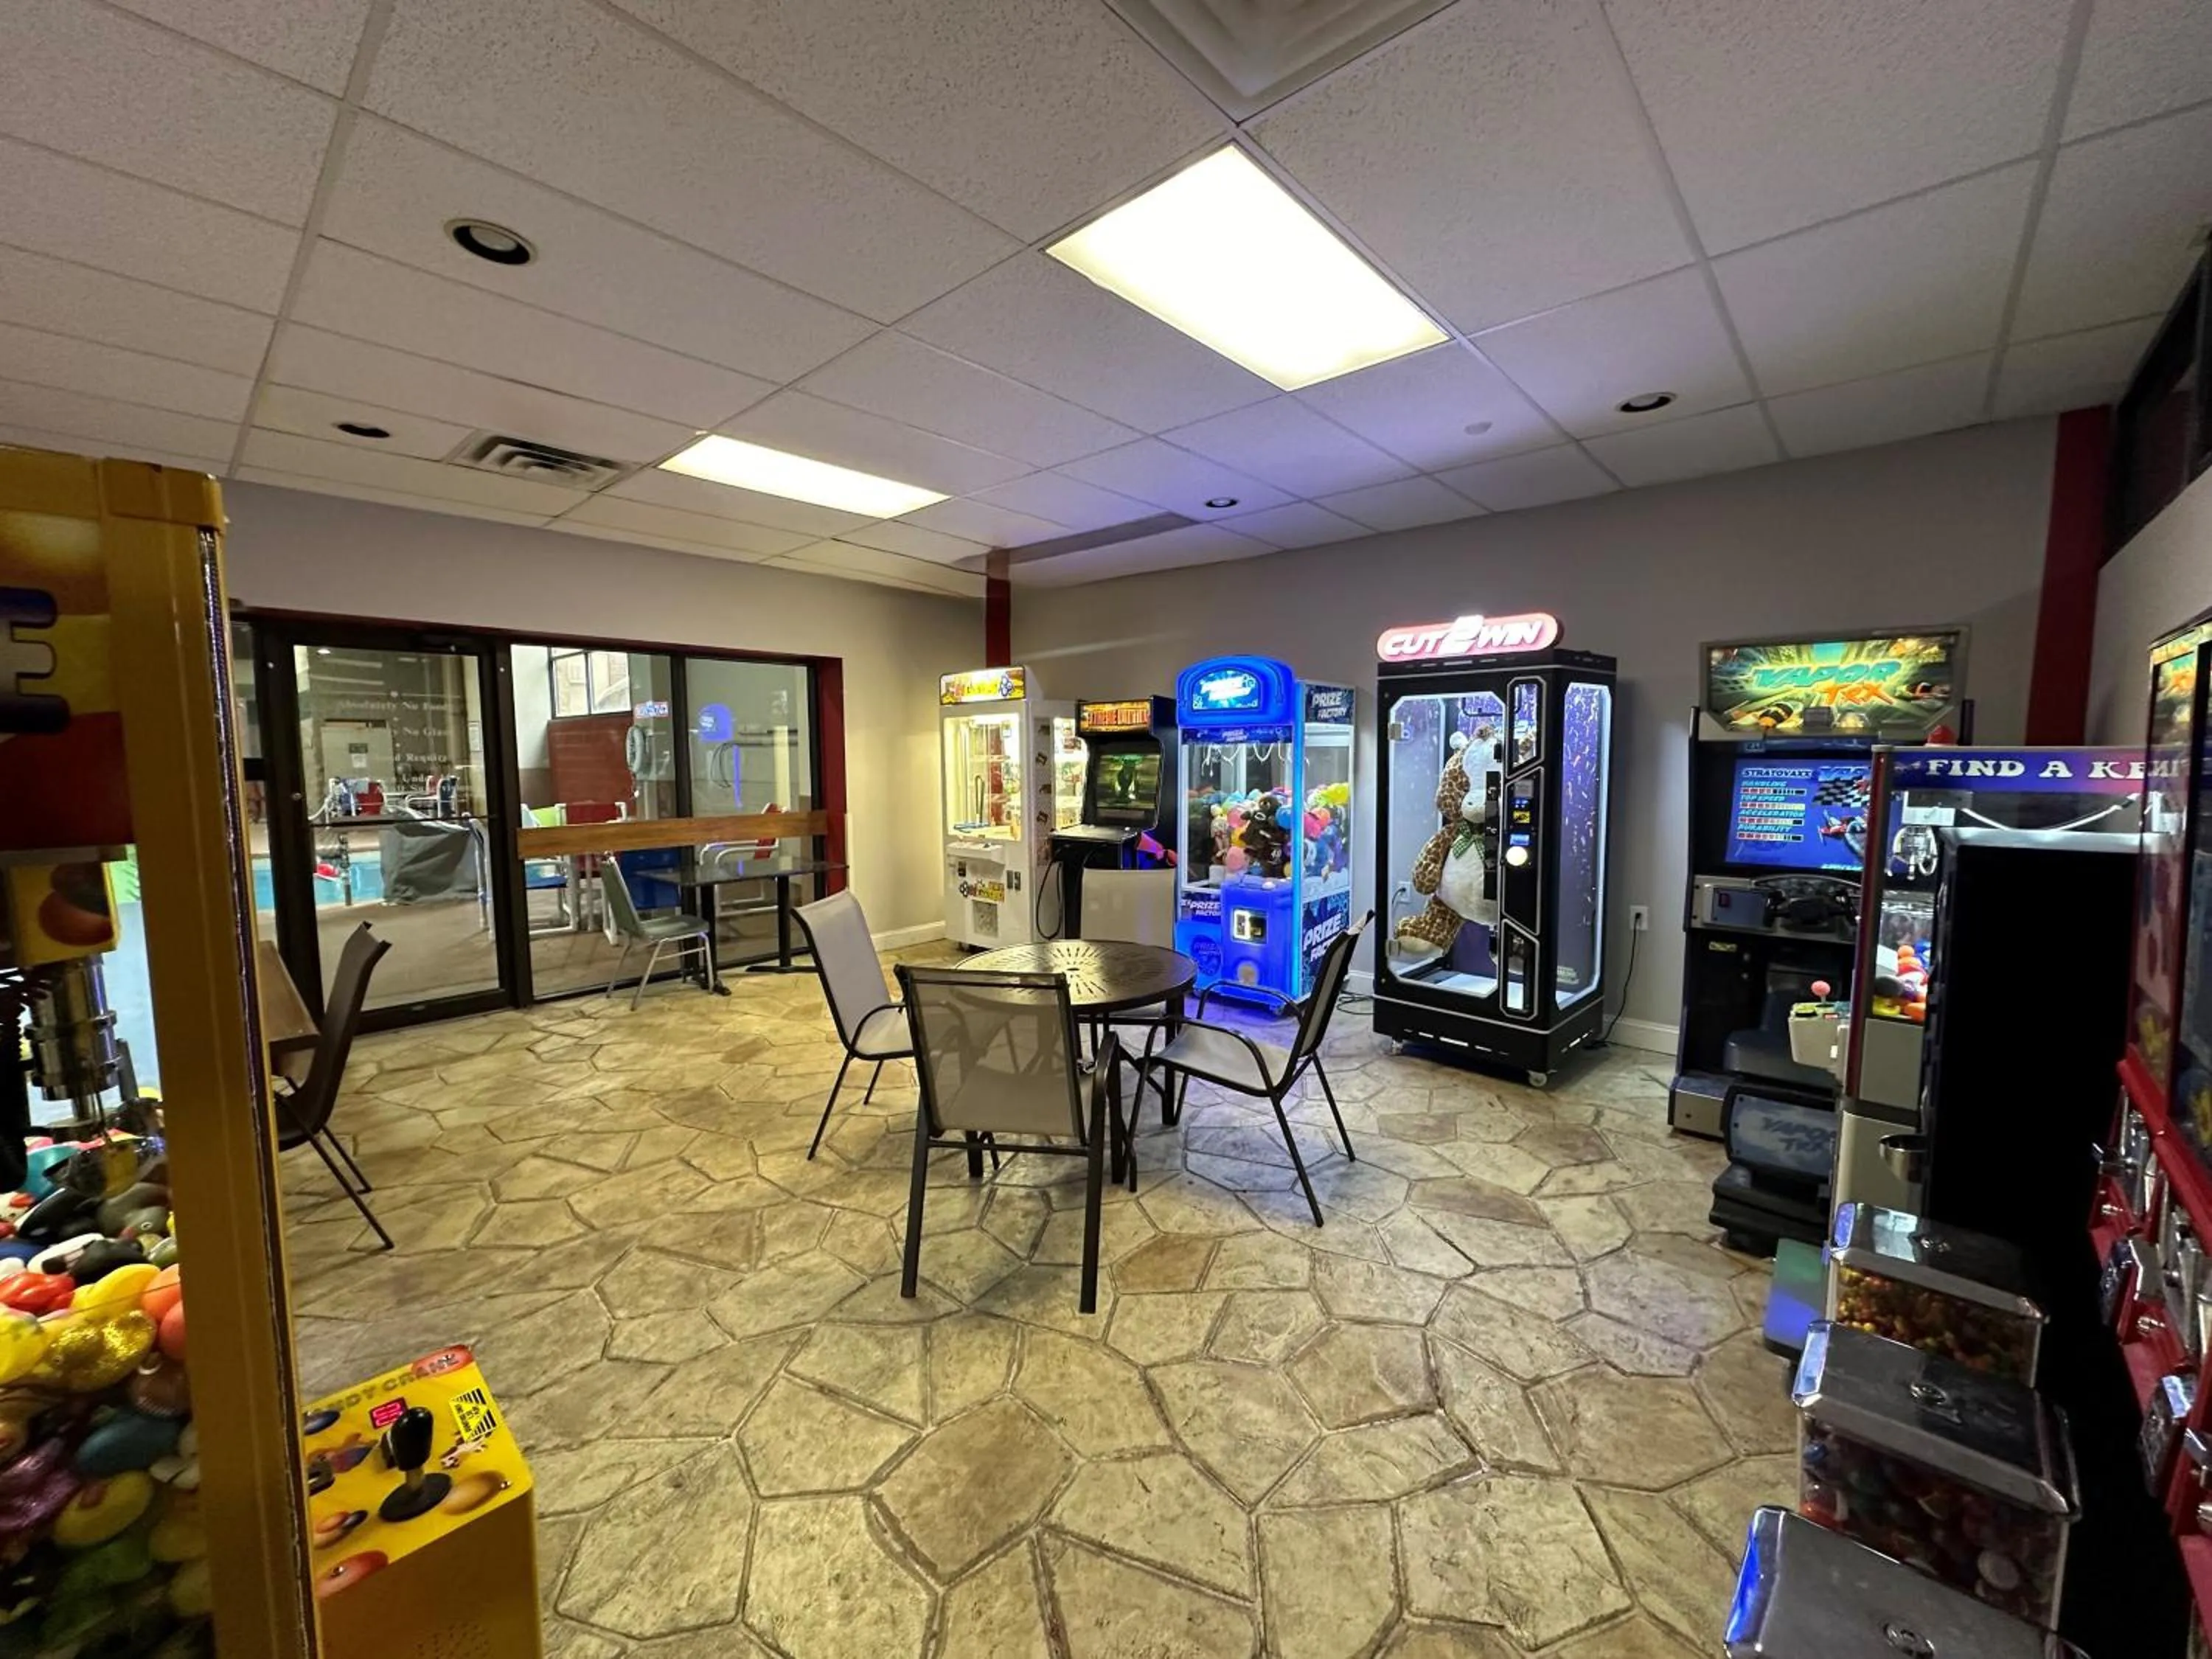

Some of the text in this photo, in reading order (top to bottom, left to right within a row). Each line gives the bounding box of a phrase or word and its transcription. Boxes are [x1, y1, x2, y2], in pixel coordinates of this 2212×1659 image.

[1752, 660, 1902, 689] VAPOR
[1312, 692, 1342, 709] PRIZE
[1926, 760, 2146, 779] FIND A KE
[1302, 913, 1342, 952] PRIZE
